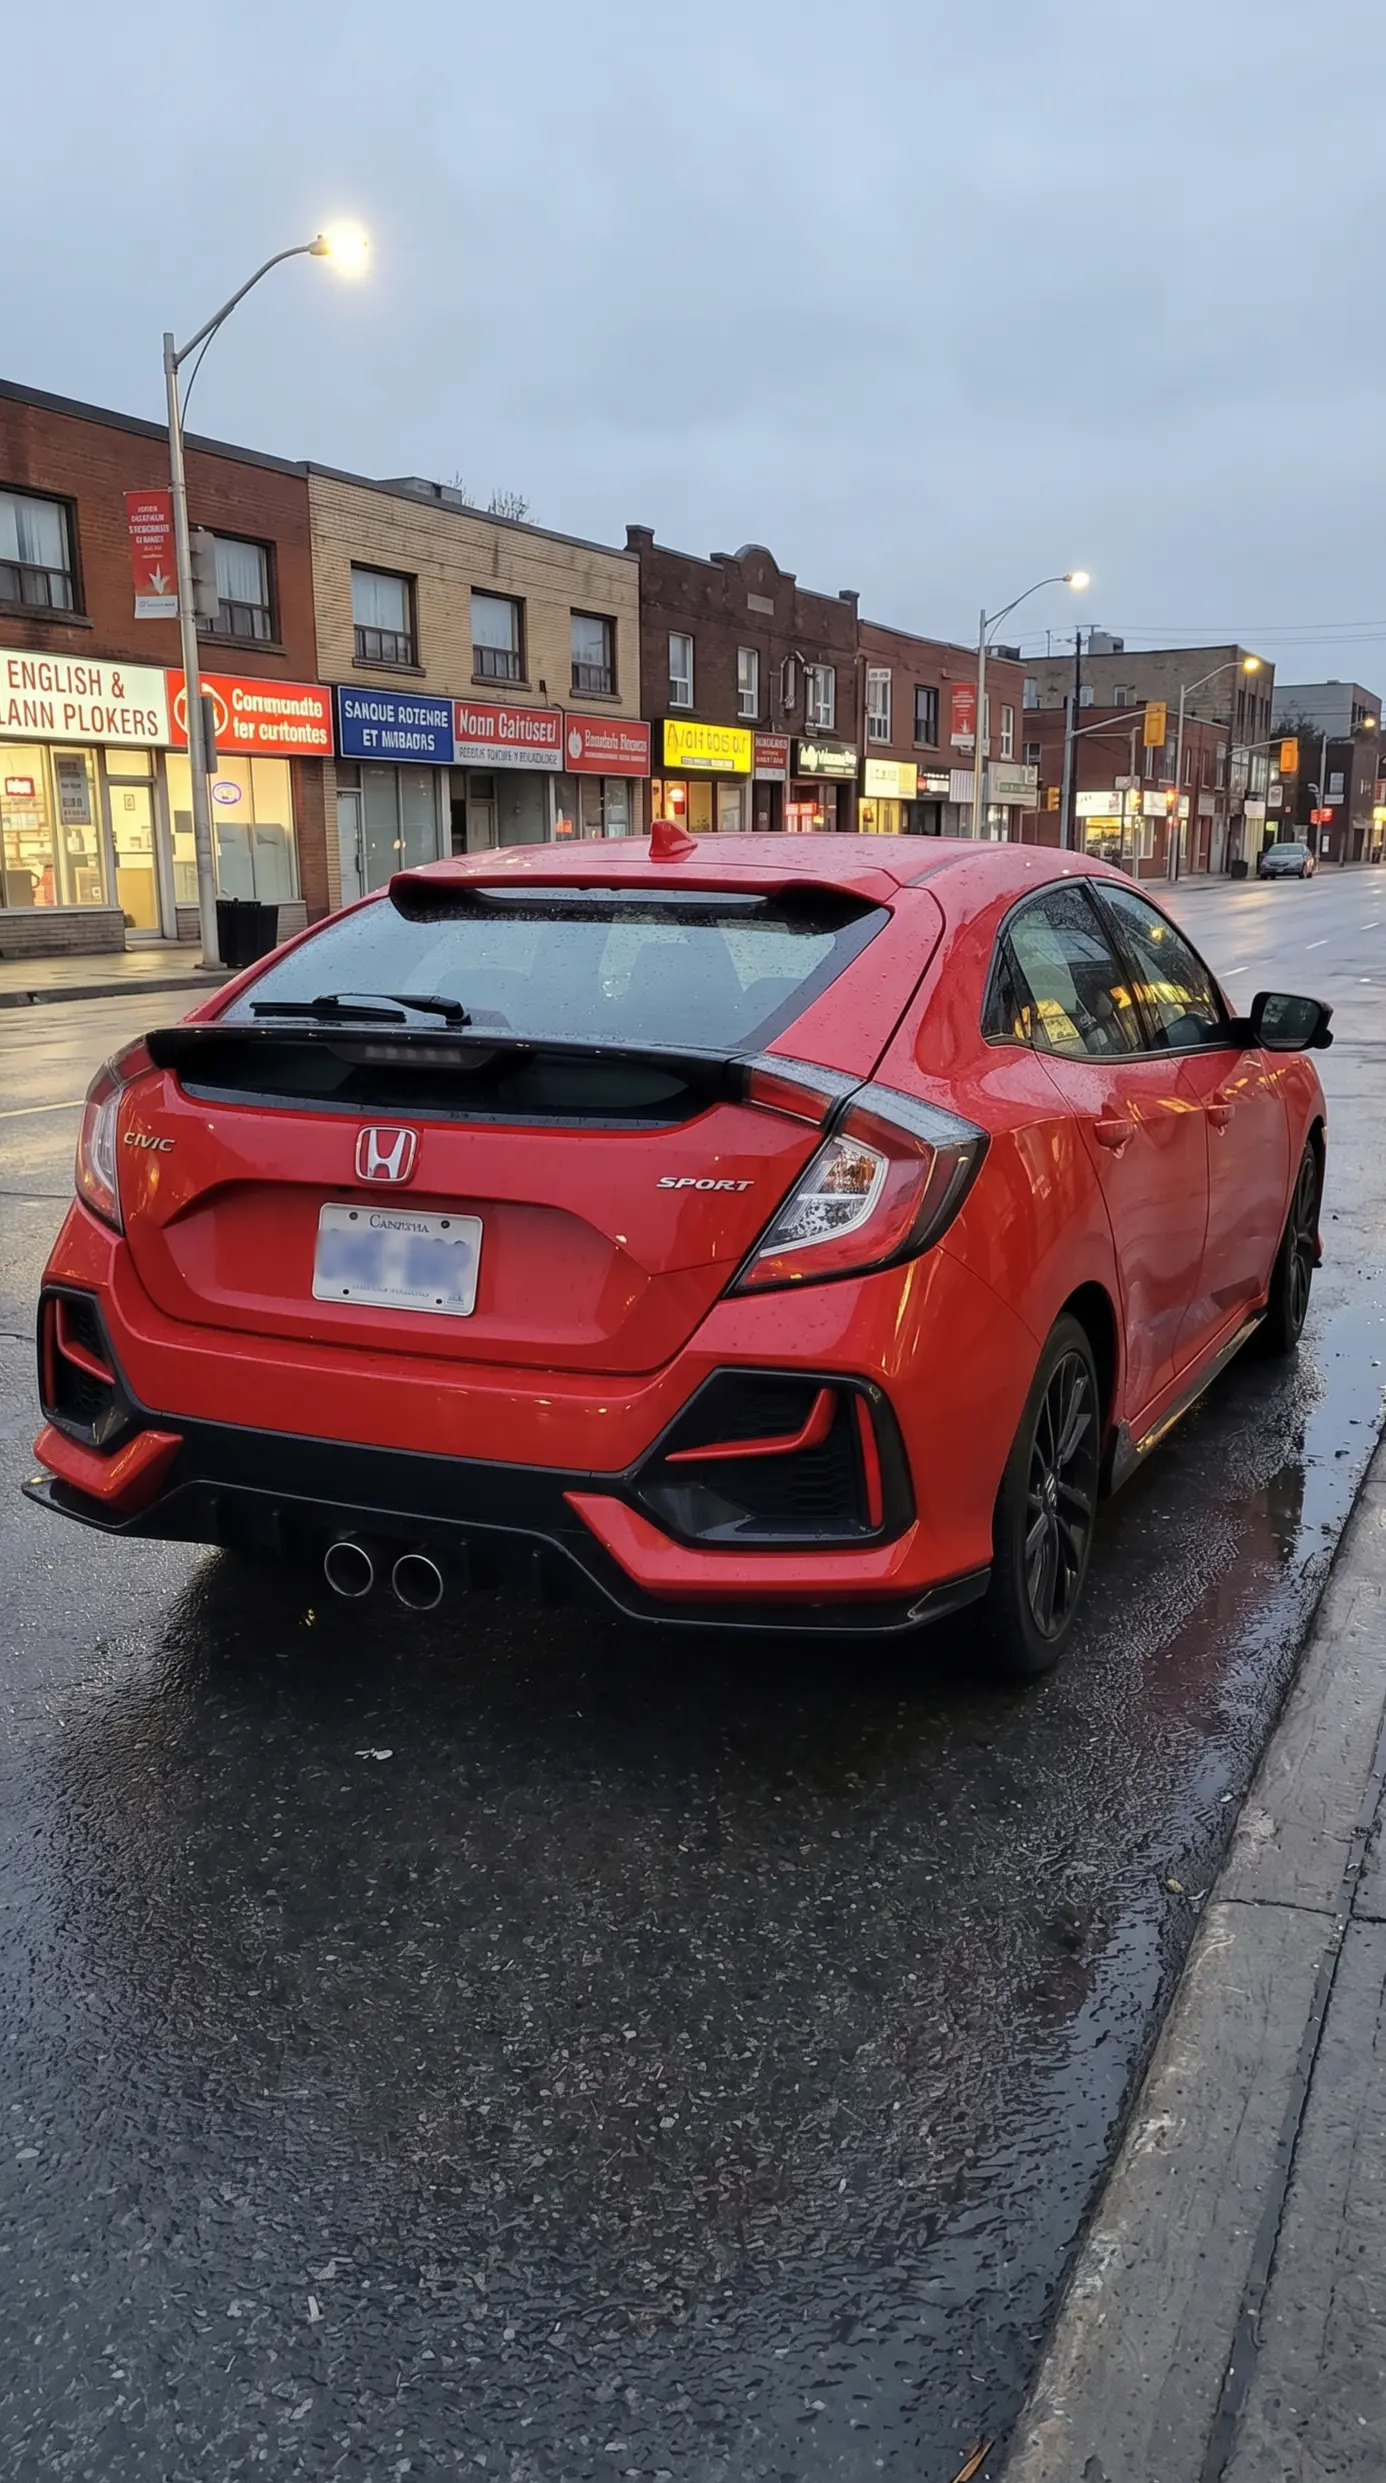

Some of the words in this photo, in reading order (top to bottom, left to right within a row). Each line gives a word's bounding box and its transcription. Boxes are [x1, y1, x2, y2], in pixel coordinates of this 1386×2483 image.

[7, 659, 102, 697] ENGLISH
[111, 671, 125, 699] &
[63, 703, 158, 737] PLOKERS
[362, 729, 379, 747] ET
[124, 1132, 176, 1151] CIVIC
[656, 1177, 755, 1191] SPORT
